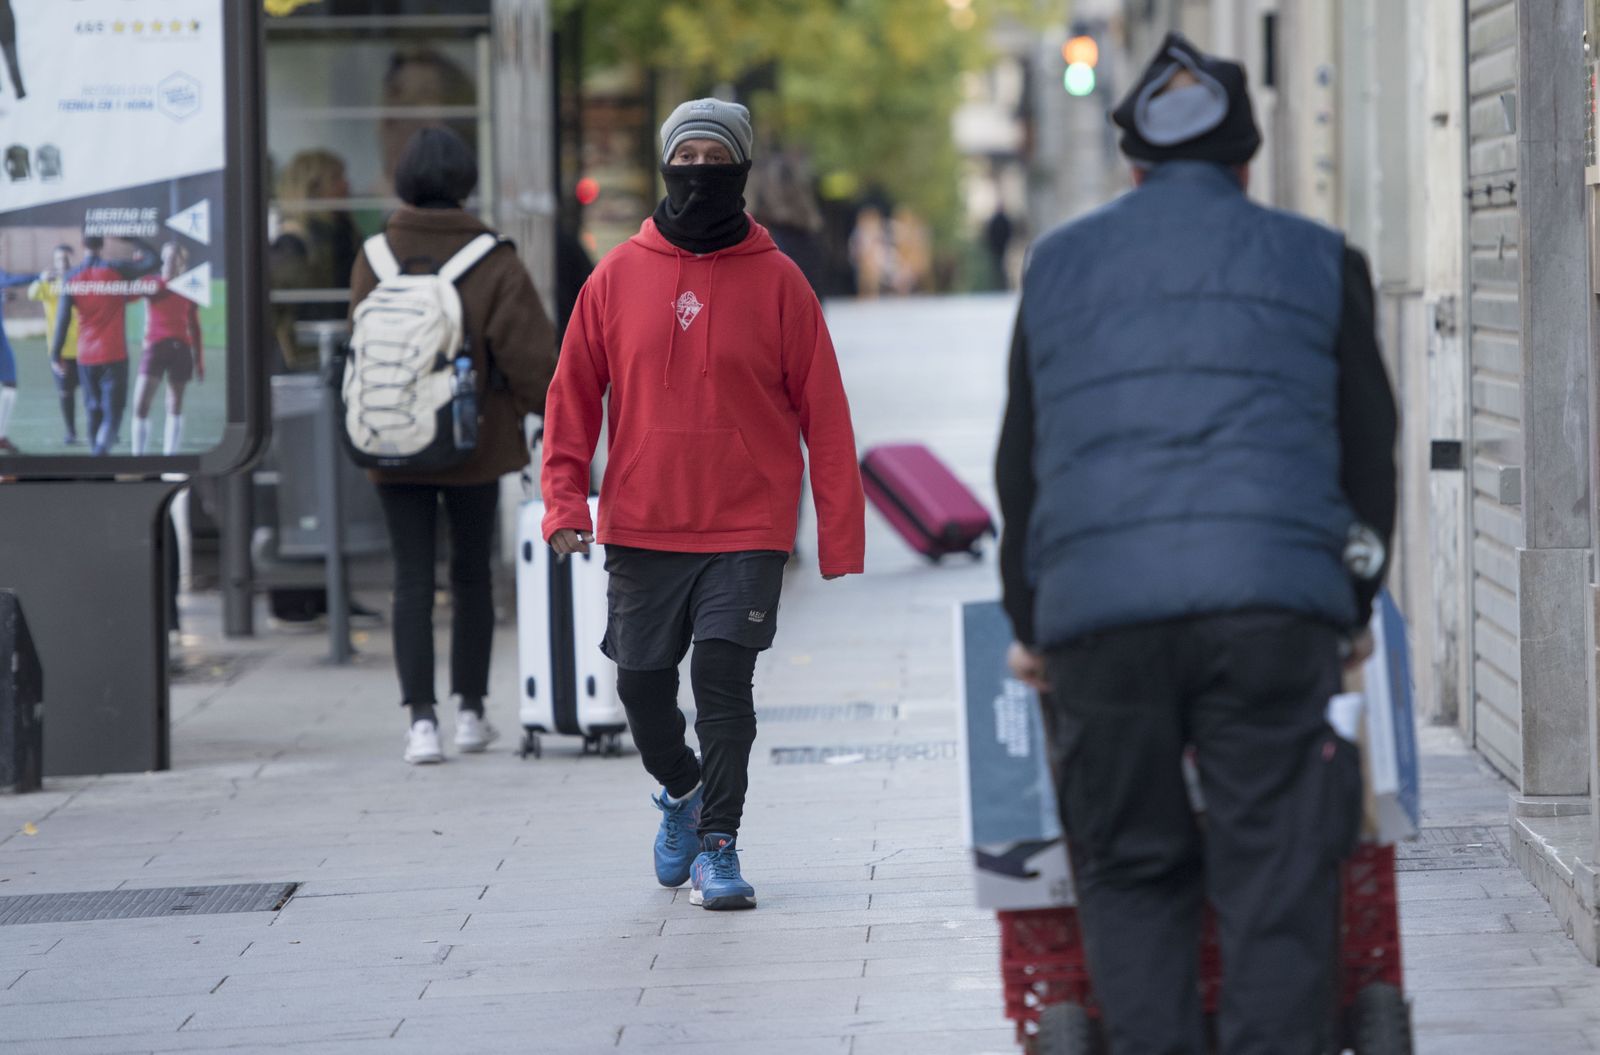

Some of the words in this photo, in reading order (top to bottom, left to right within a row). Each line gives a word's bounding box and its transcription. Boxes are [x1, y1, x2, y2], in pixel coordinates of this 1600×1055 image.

[85, 208, 138, 221] LIBERTAD
[140, 207, 158, 220] DE
[84, 222, 158, 236] MOVIMIENTO
[50, 280, 157, 296] TRANSPIRABILIDAD
